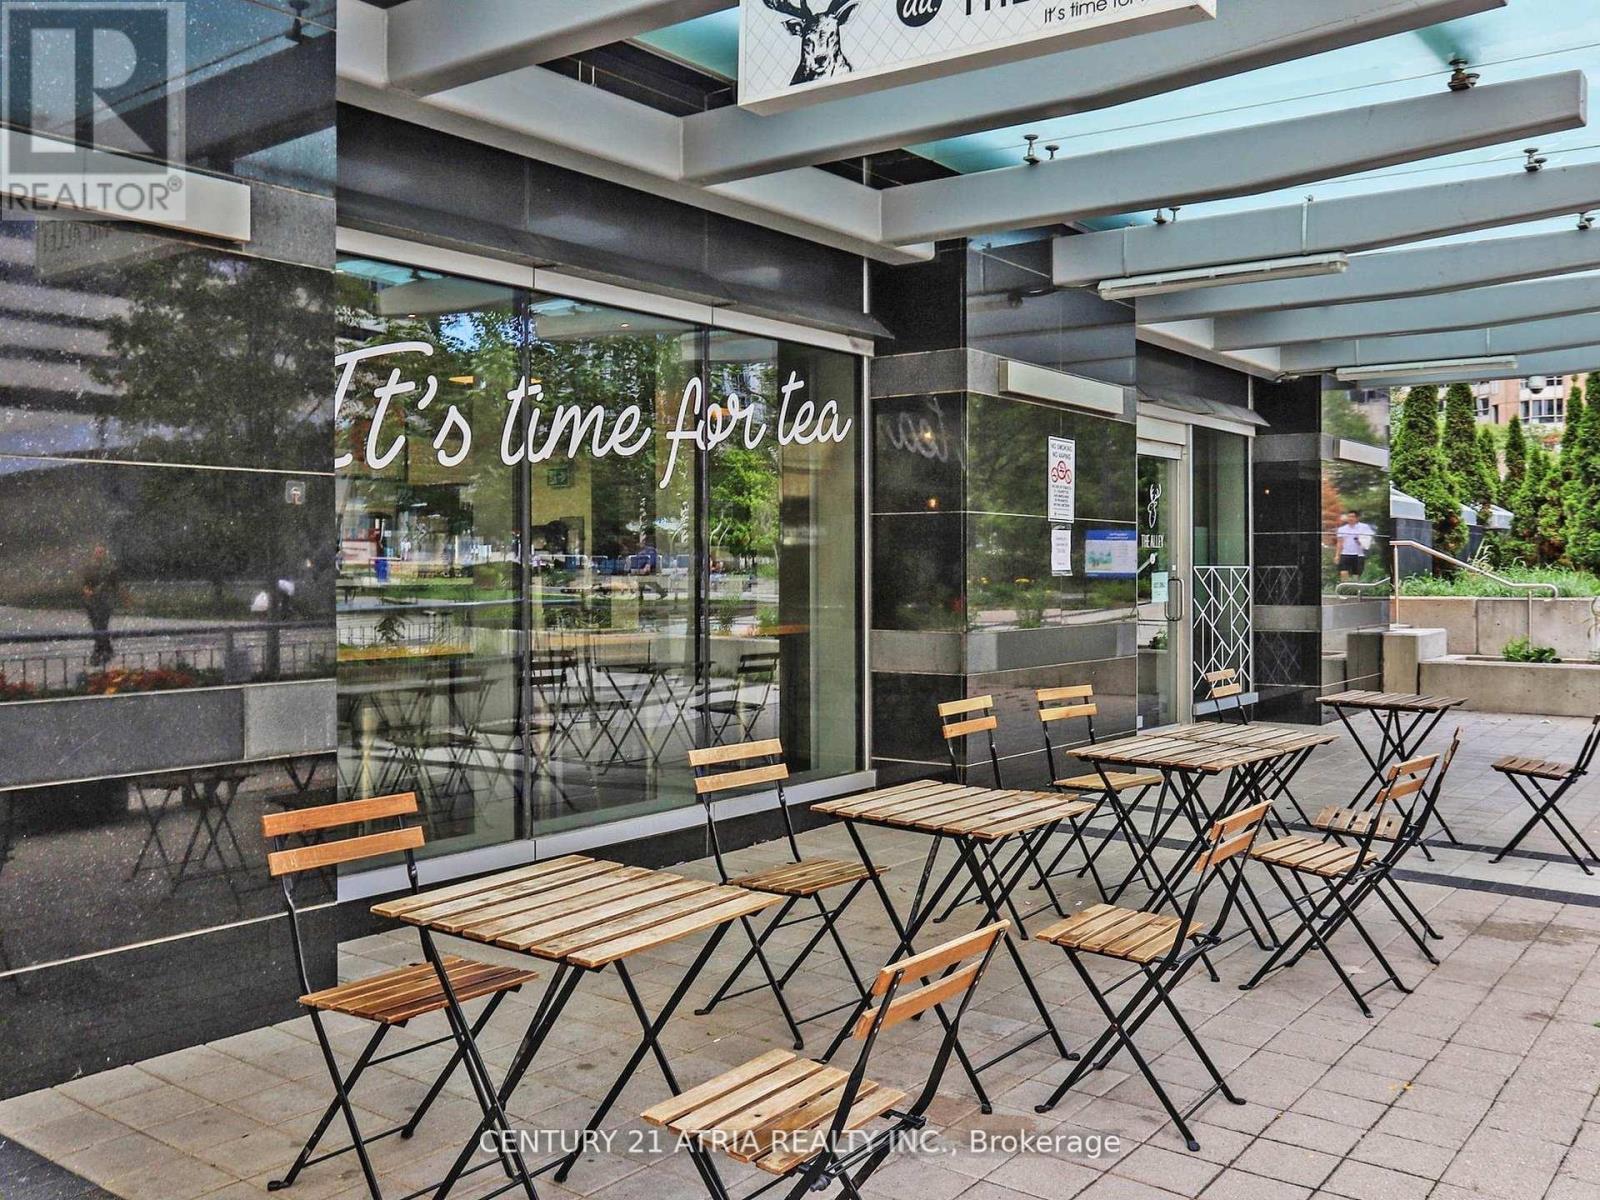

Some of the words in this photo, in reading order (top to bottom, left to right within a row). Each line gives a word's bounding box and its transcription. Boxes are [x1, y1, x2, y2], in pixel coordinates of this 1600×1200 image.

[1044, 7, 1066, 23] It's
[1070, 0, 1107, 17] time
[501, 375, 651, 466] time
[659, 376, 767, 489] for
[777, 370, 852, 445] tea
[1141, 534, 1150, 548] THE
